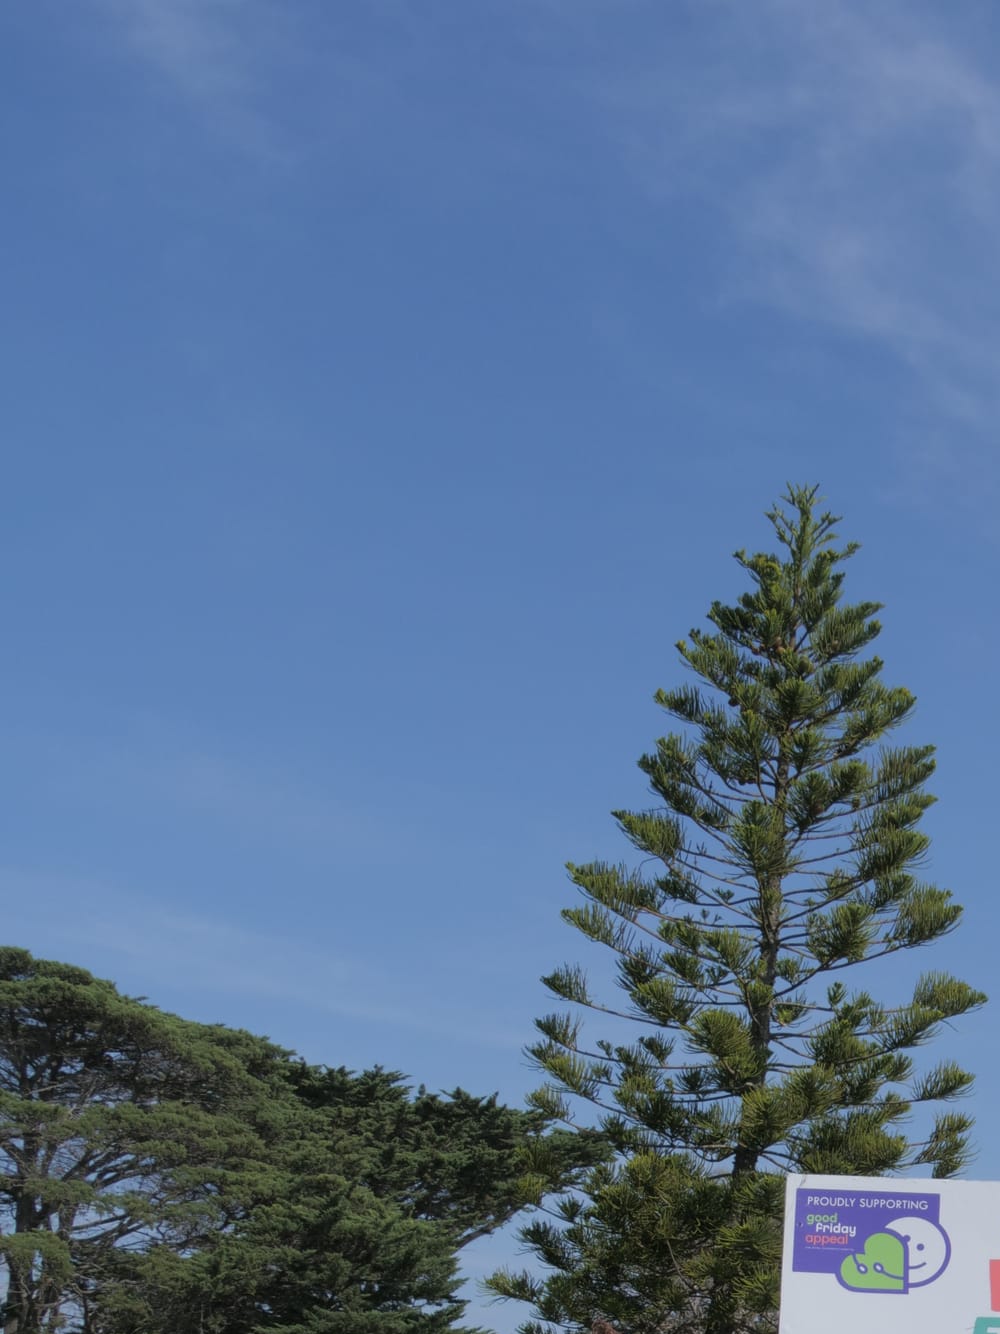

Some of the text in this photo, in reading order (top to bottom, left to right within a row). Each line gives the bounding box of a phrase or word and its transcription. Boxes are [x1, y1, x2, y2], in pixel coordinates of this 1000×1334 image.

[807, 1196, 929, 1210] PROUDLY SUPPORTING
[806, 1213, 838, 1225] good
[815, 1222, 857, 1237] friday
[805, 1233, 849, 1246] appeal
